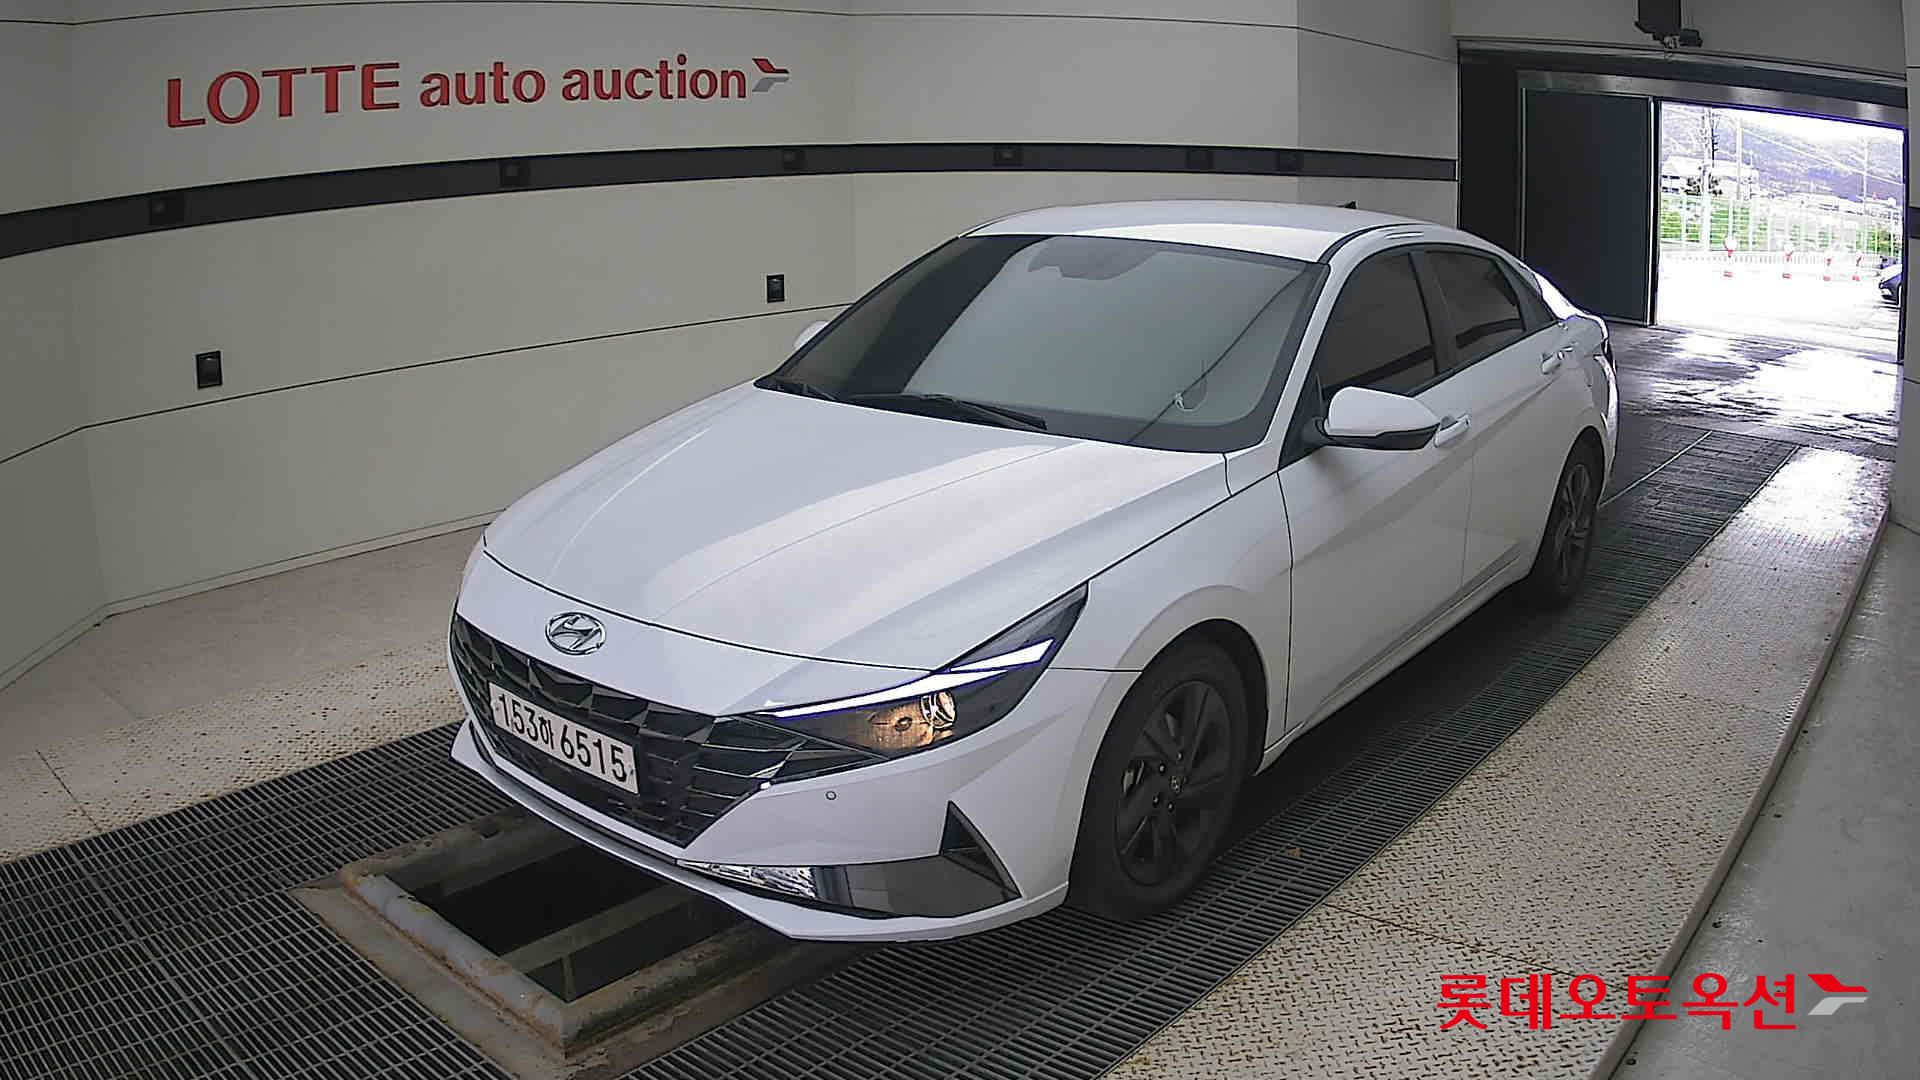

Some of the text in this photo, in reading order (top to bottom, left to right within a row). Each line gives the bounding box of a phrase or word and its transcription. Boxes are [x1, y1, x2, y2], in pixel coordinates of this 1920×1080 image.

[166, 53, 748, 129] LOTTE auto auction
[560, 724, 627, 782] 6515
